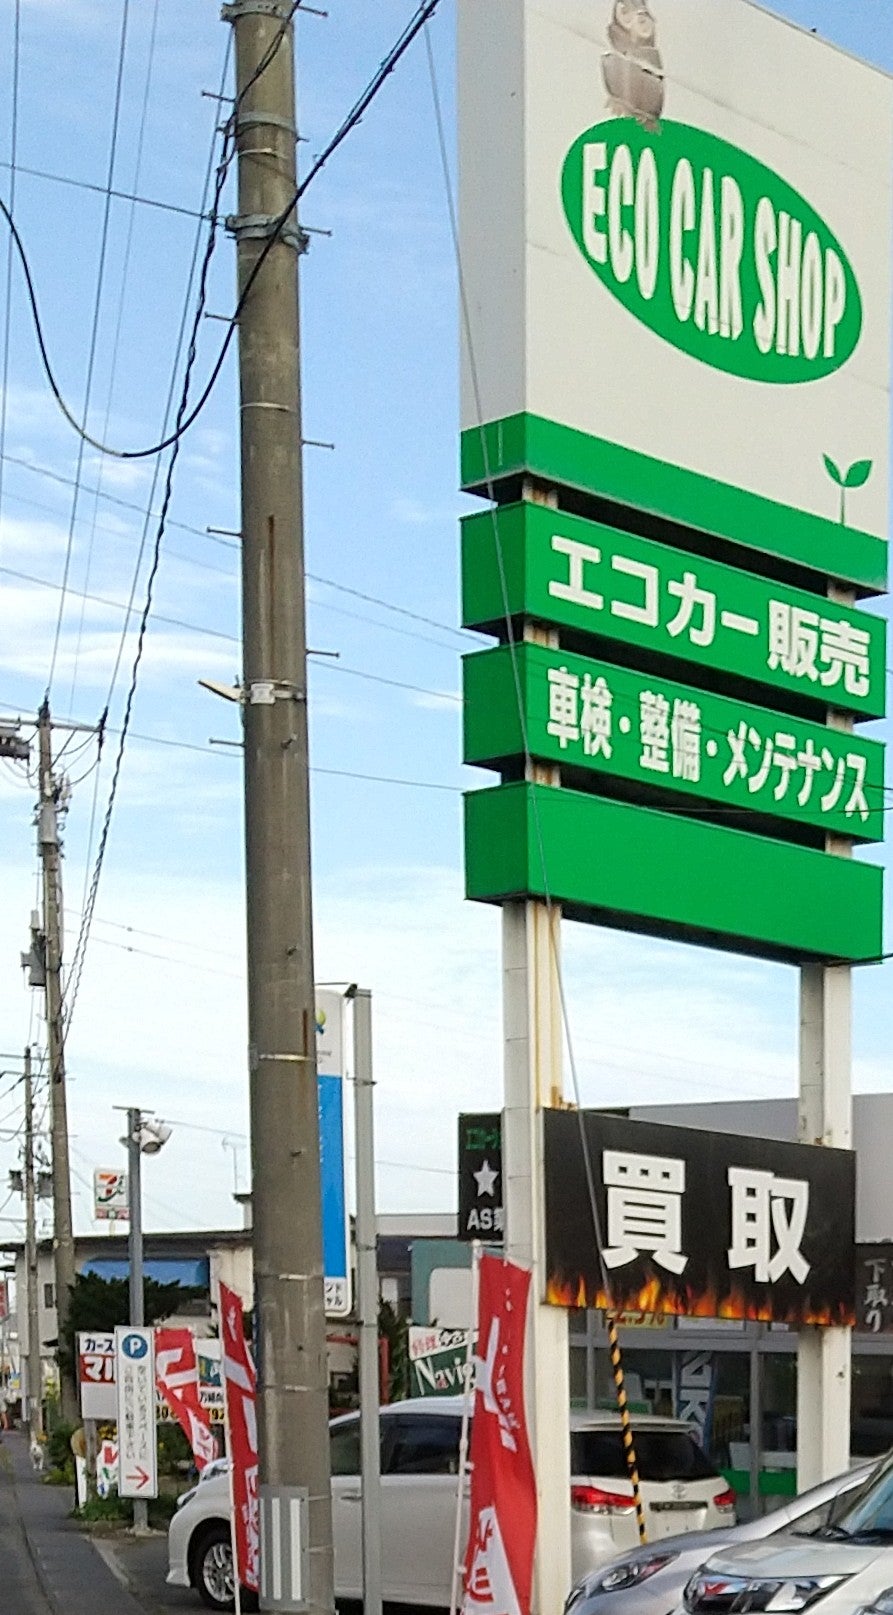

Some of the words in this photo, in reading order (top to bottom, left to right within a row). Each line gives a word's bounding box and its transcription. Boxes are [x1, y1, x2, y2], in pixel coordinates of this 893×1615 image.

[581, 141, 660, 300] ECO
[669, 157, 745, 341] CAR
[752, 196, 847, 360] SHOP
[548, 534, 871, 697] エコカー販売
[547, 666, 869, 822] 車検・整備・メンテナンス
[129, 1338, 142, 1355] P
